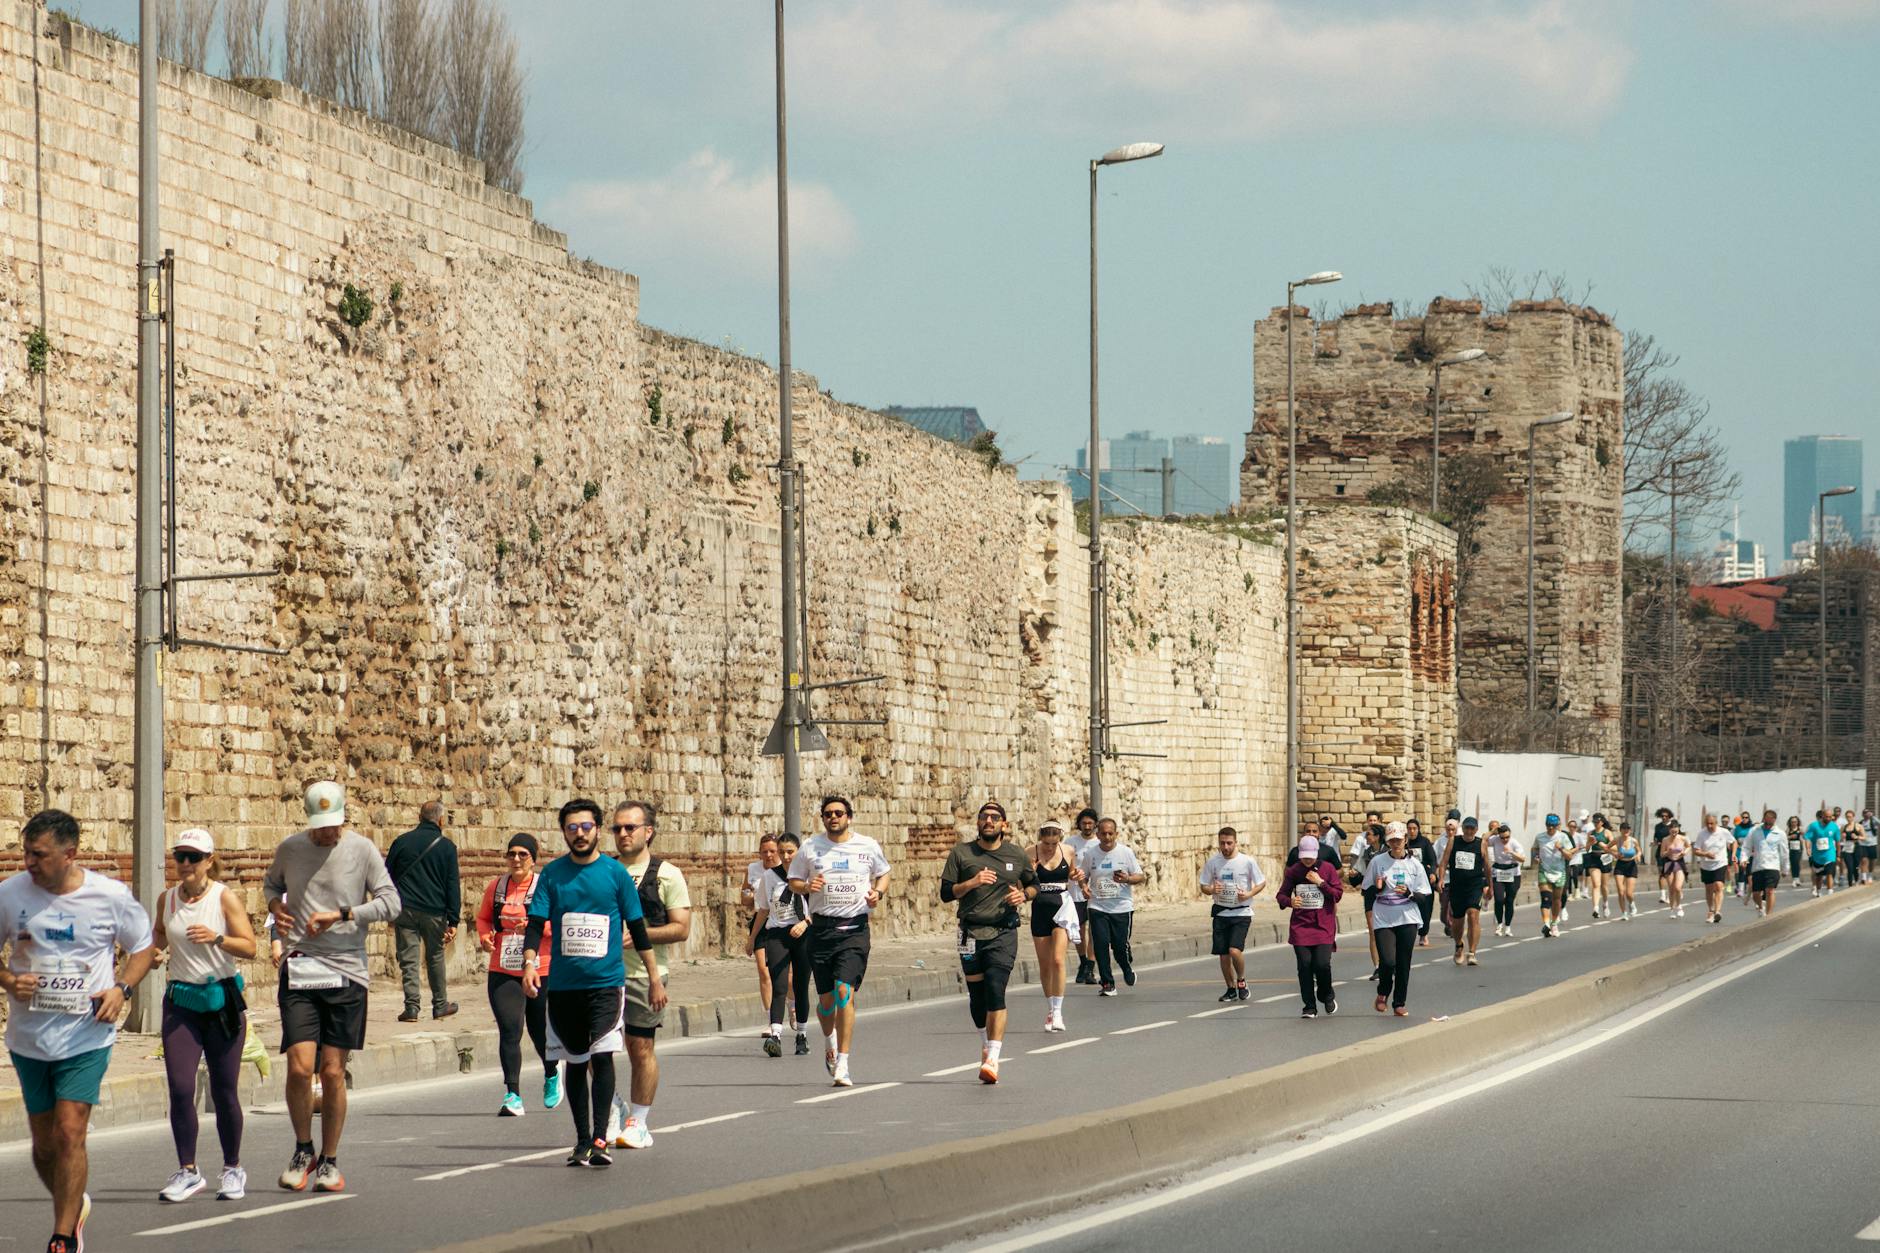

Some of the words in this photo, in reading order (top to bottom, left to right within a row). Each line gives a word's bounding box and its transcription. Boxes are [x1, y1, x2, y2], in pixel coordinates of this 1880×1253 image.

[827, 884, 833, 893] E
[835, 884, 857, 893] 4280
[566, 927, 575, 937] G
[577, 928, 604, 939] 5852
[505, 946, 512, 955] G
[37, 976, 48, 989] G
[51, 977, 84, 990] 6392
